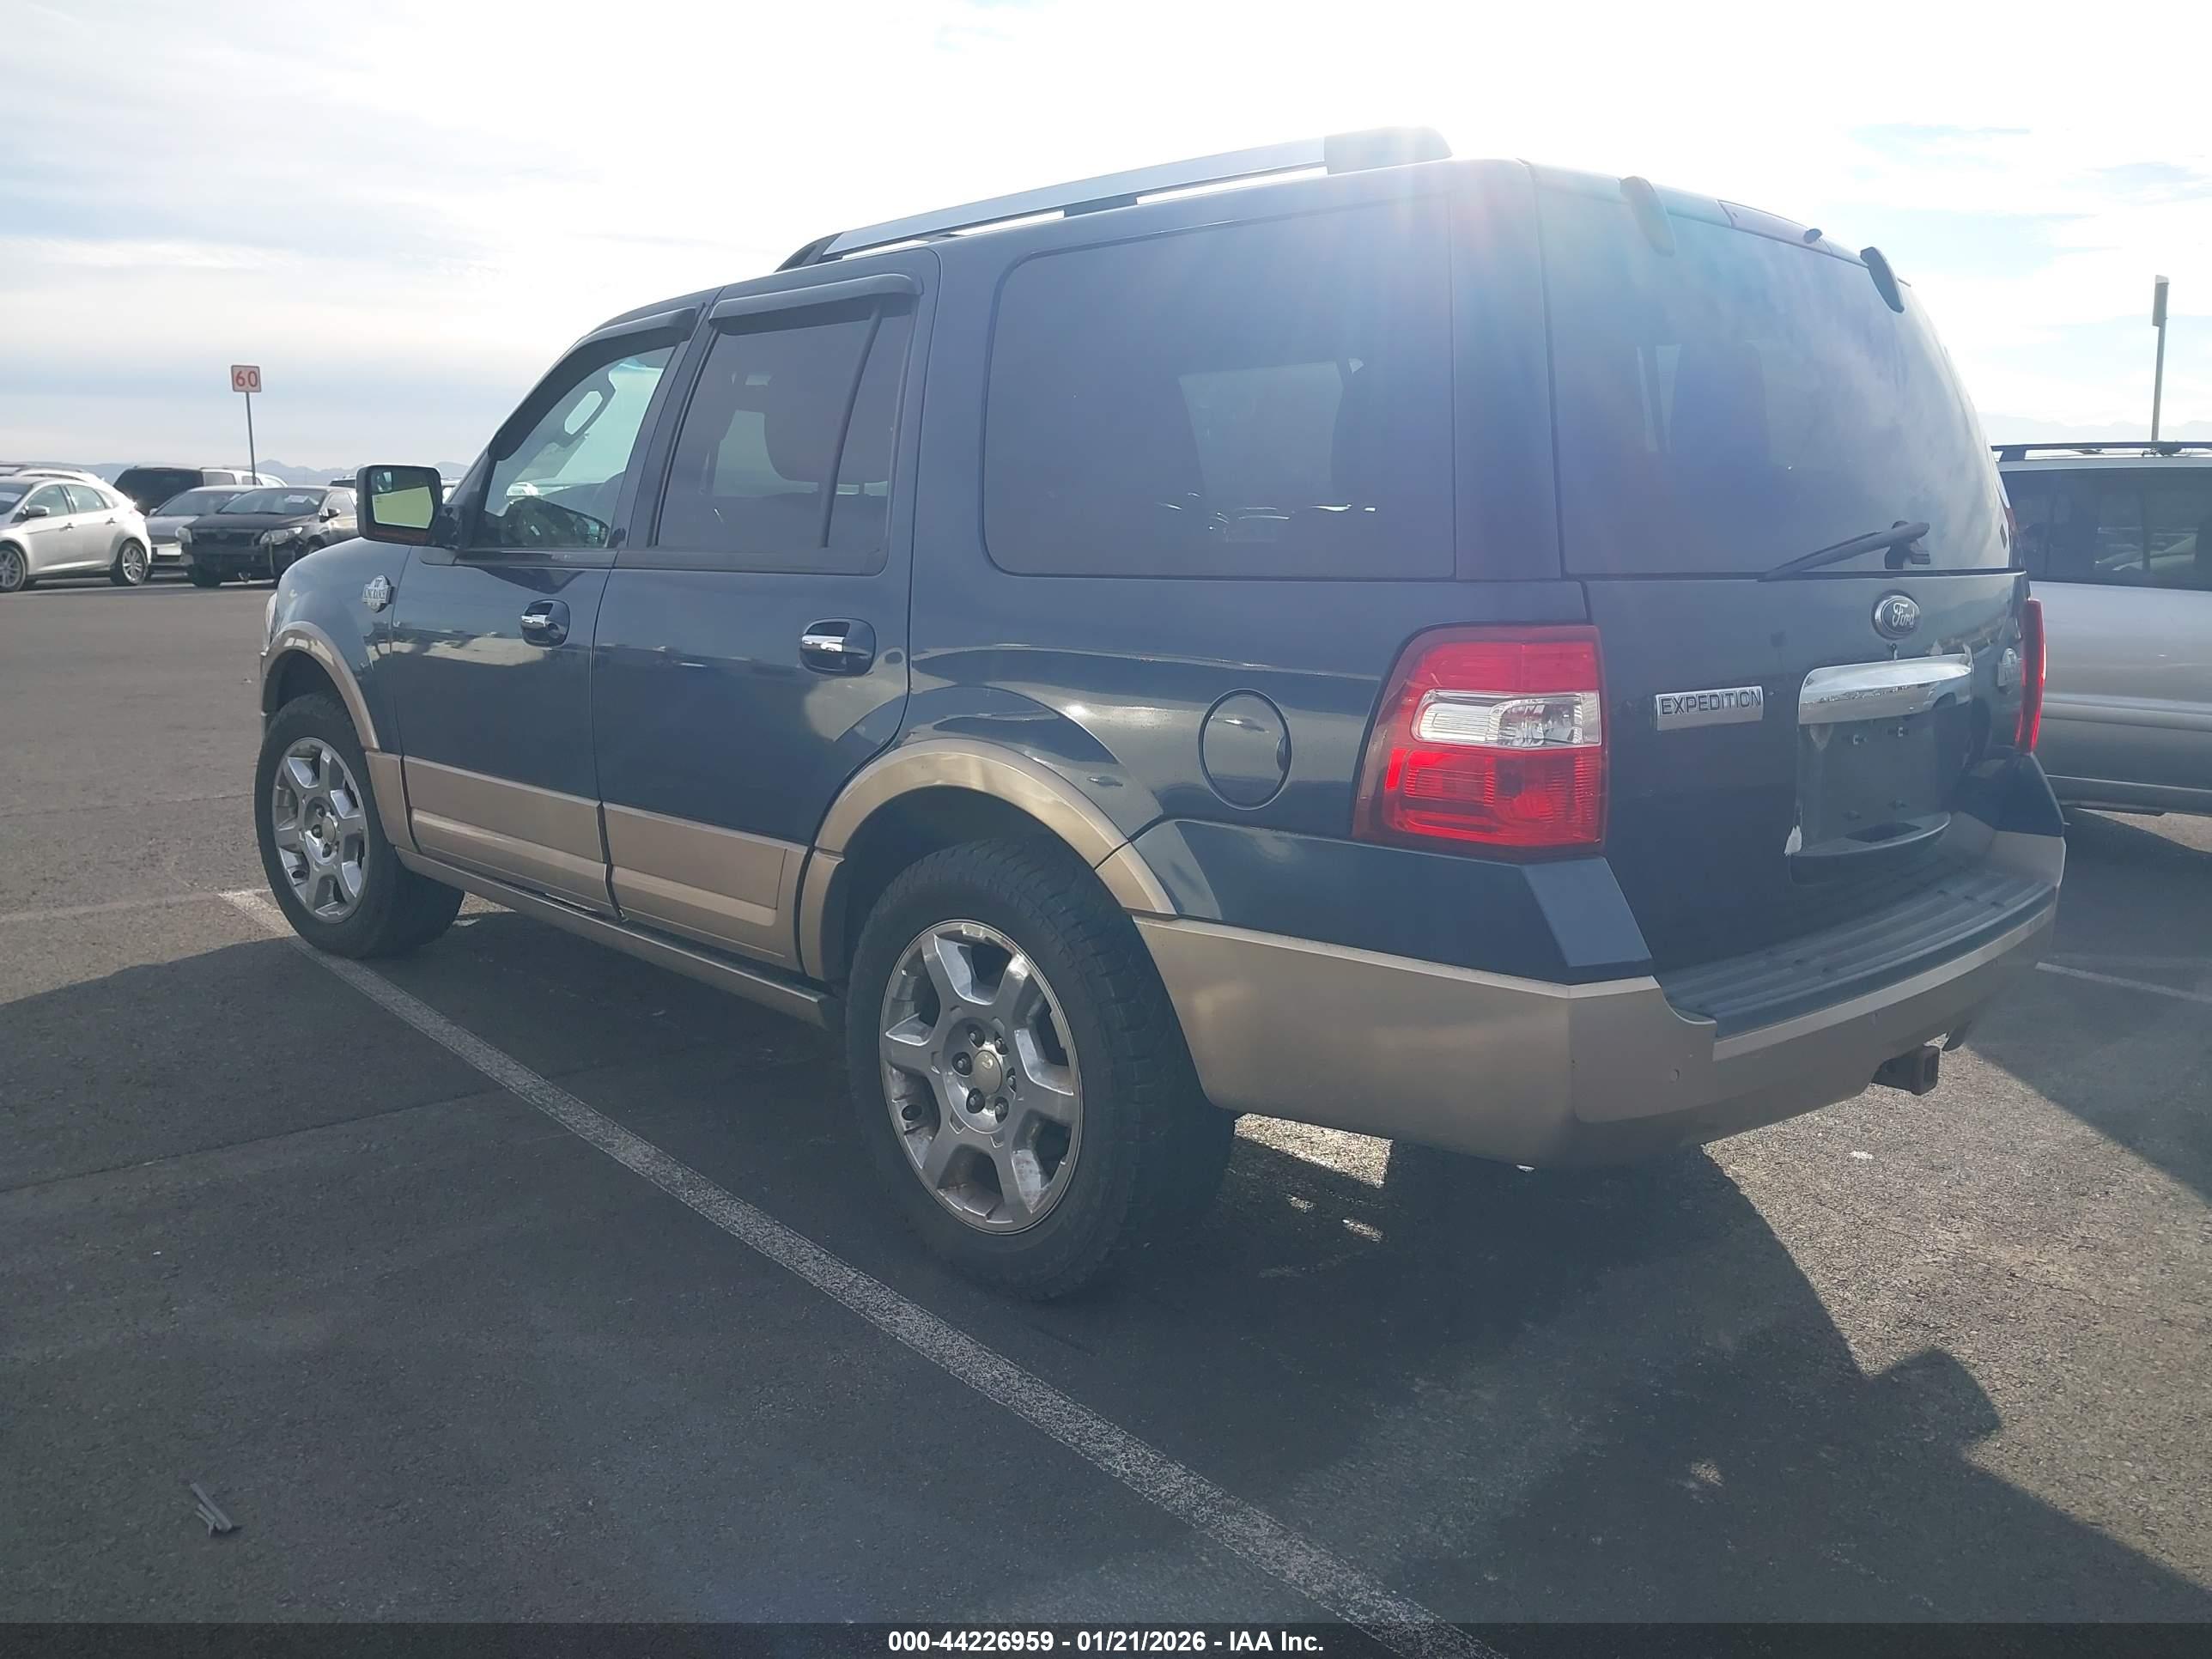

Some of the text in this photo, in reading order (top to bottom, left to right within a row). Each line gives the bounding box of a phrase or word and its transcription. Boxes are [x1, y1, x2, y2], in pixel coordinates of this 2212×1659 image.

[235, 370, 258, 387] 60
[1892, 602, 1915, 628] Ford
[1660, 690, 1762, 715] EXPEDITION
